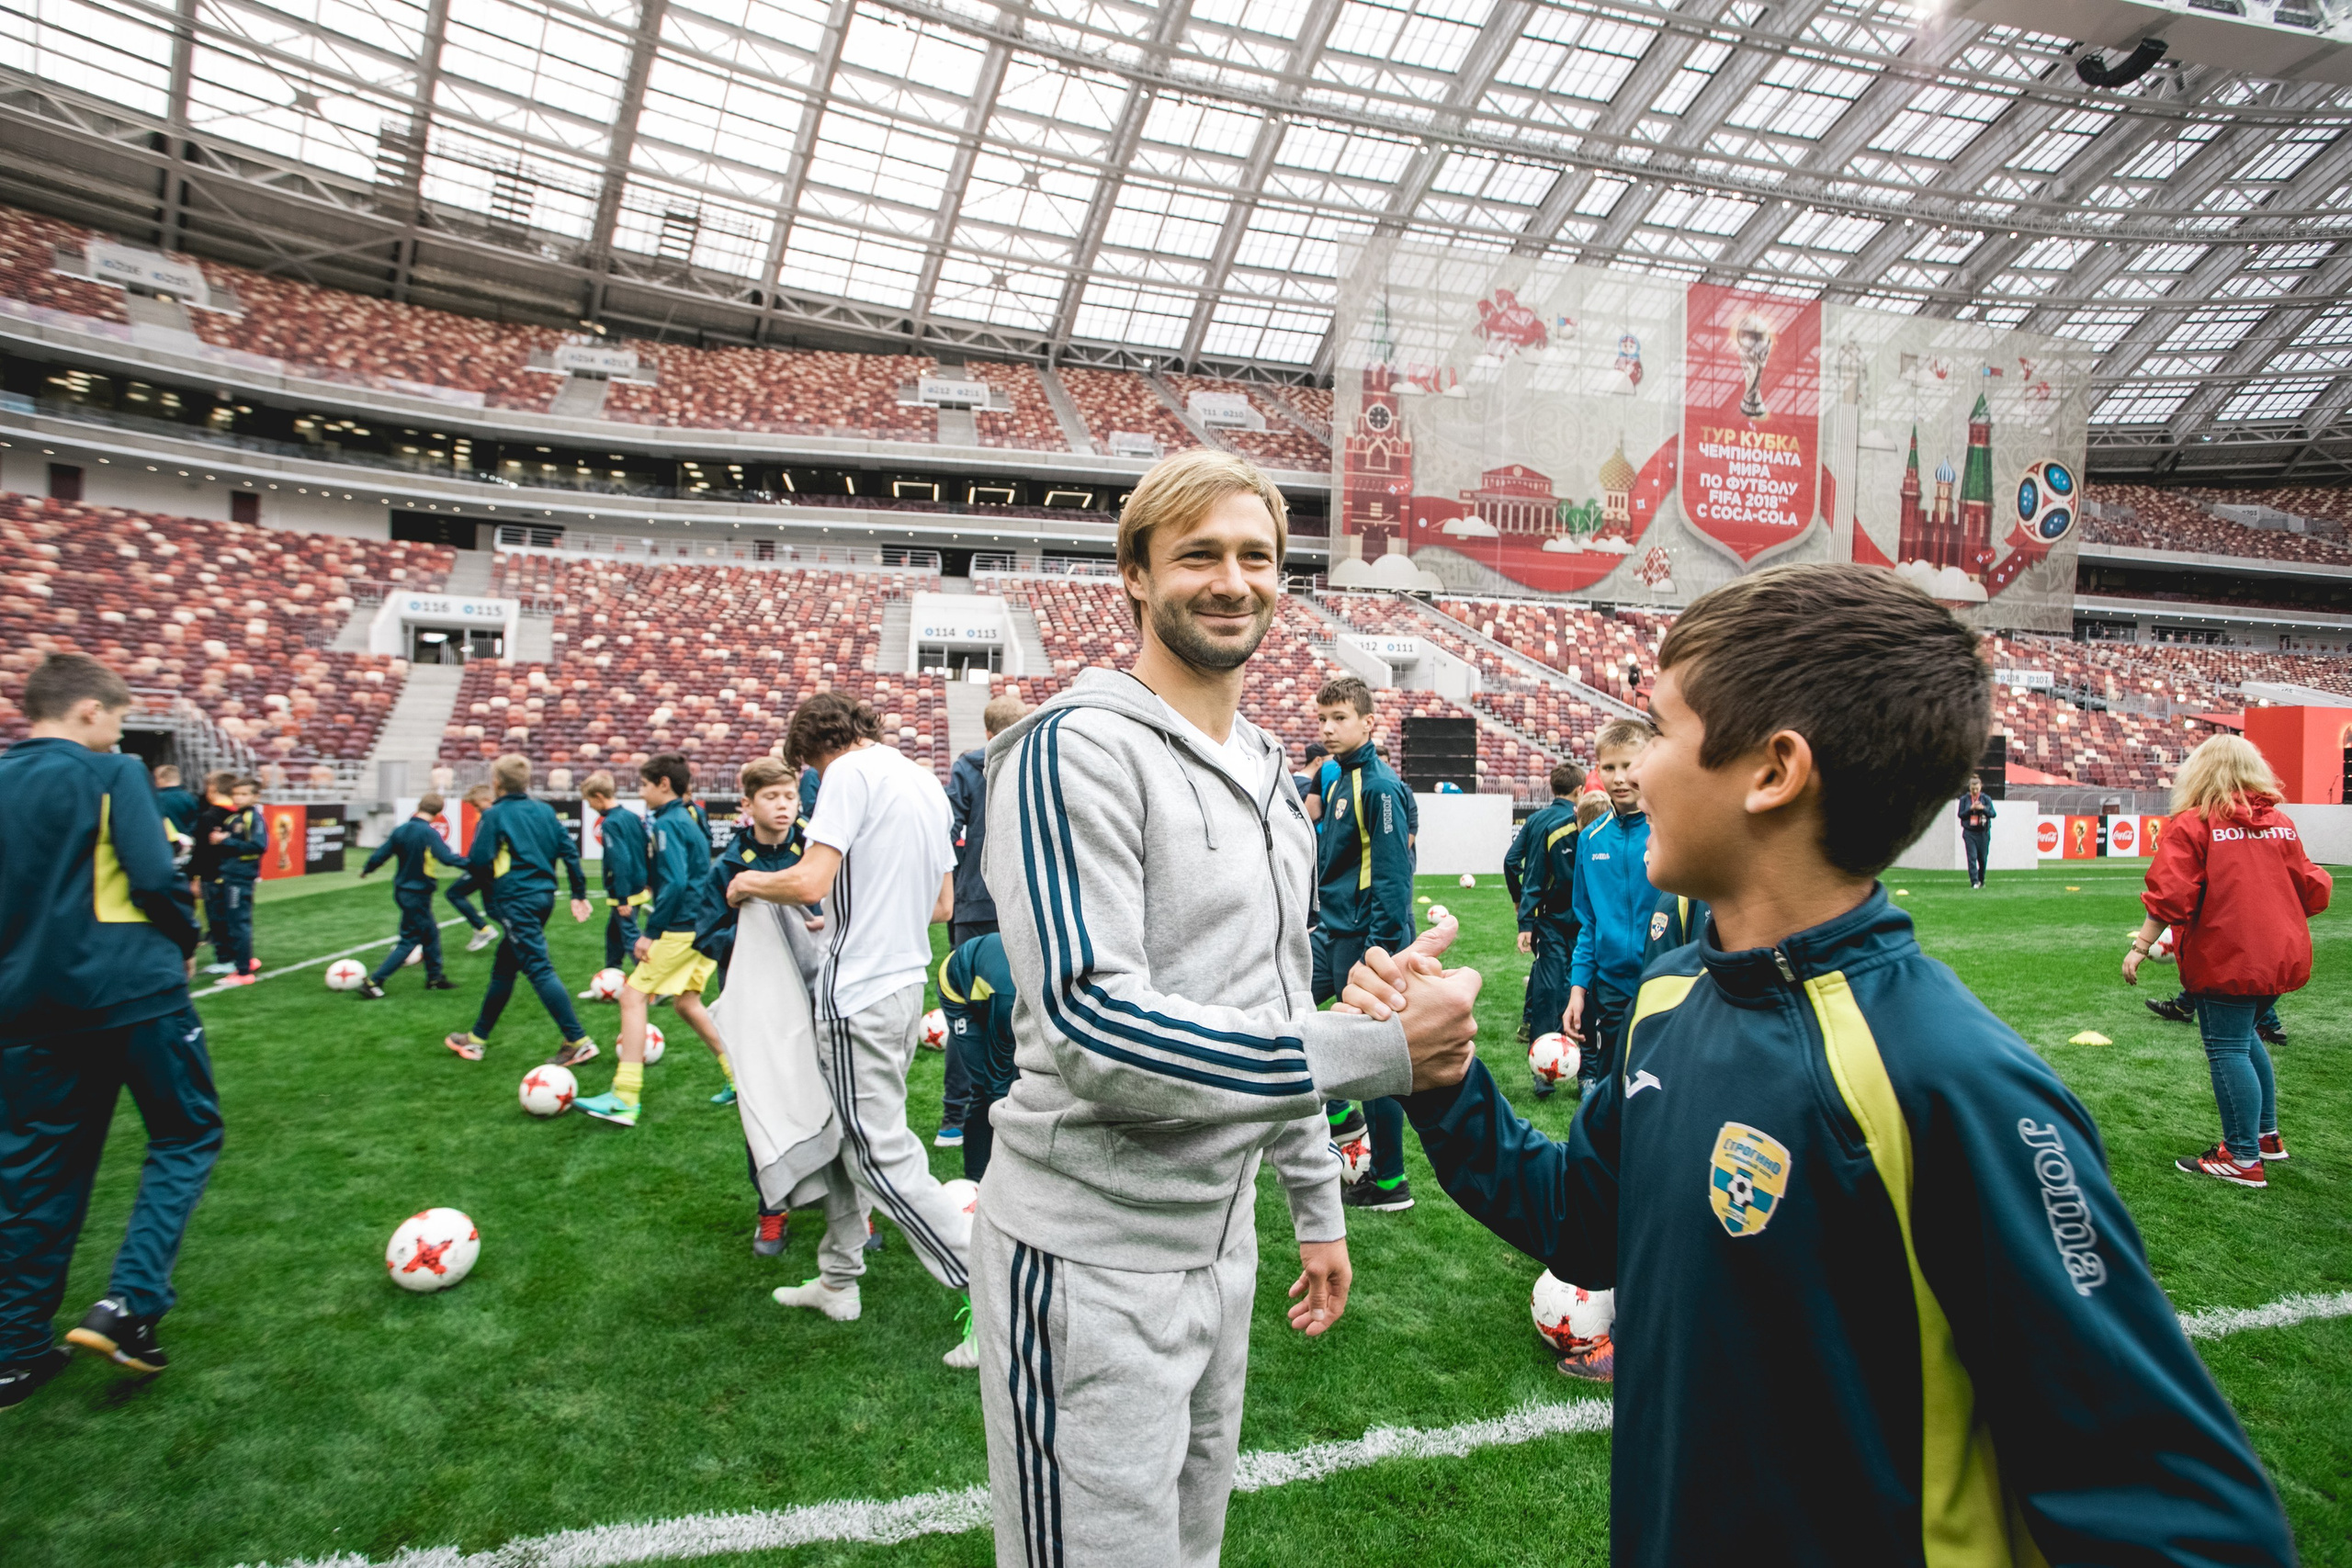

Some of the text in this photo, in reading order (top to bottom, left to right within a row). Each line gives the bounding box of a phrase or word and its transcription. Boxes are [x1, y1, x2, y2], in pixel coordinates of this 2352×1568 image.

[1700, 425, 1801, 453] ТУР КУБКА
[1699, 442, 1802, 468] ЧЕМПИОНАТА
[1728, 461, 1771, 479] МИРА
[1700, 473, 1798, 496] ПО ФУТБОЛУ
[1709, 489, 1742, 506] FIFA
[1711, 505, 1798, 526] COCA-COLA
[935, 627, 956, 637] 114
[1396, 643, 1414, 652] 111
[955, 1017, 967, 1035] 19
[1724, 1138, 1781, 1176] СТРОГИНО
[2018, 1117, 2108, 1297] Joma
